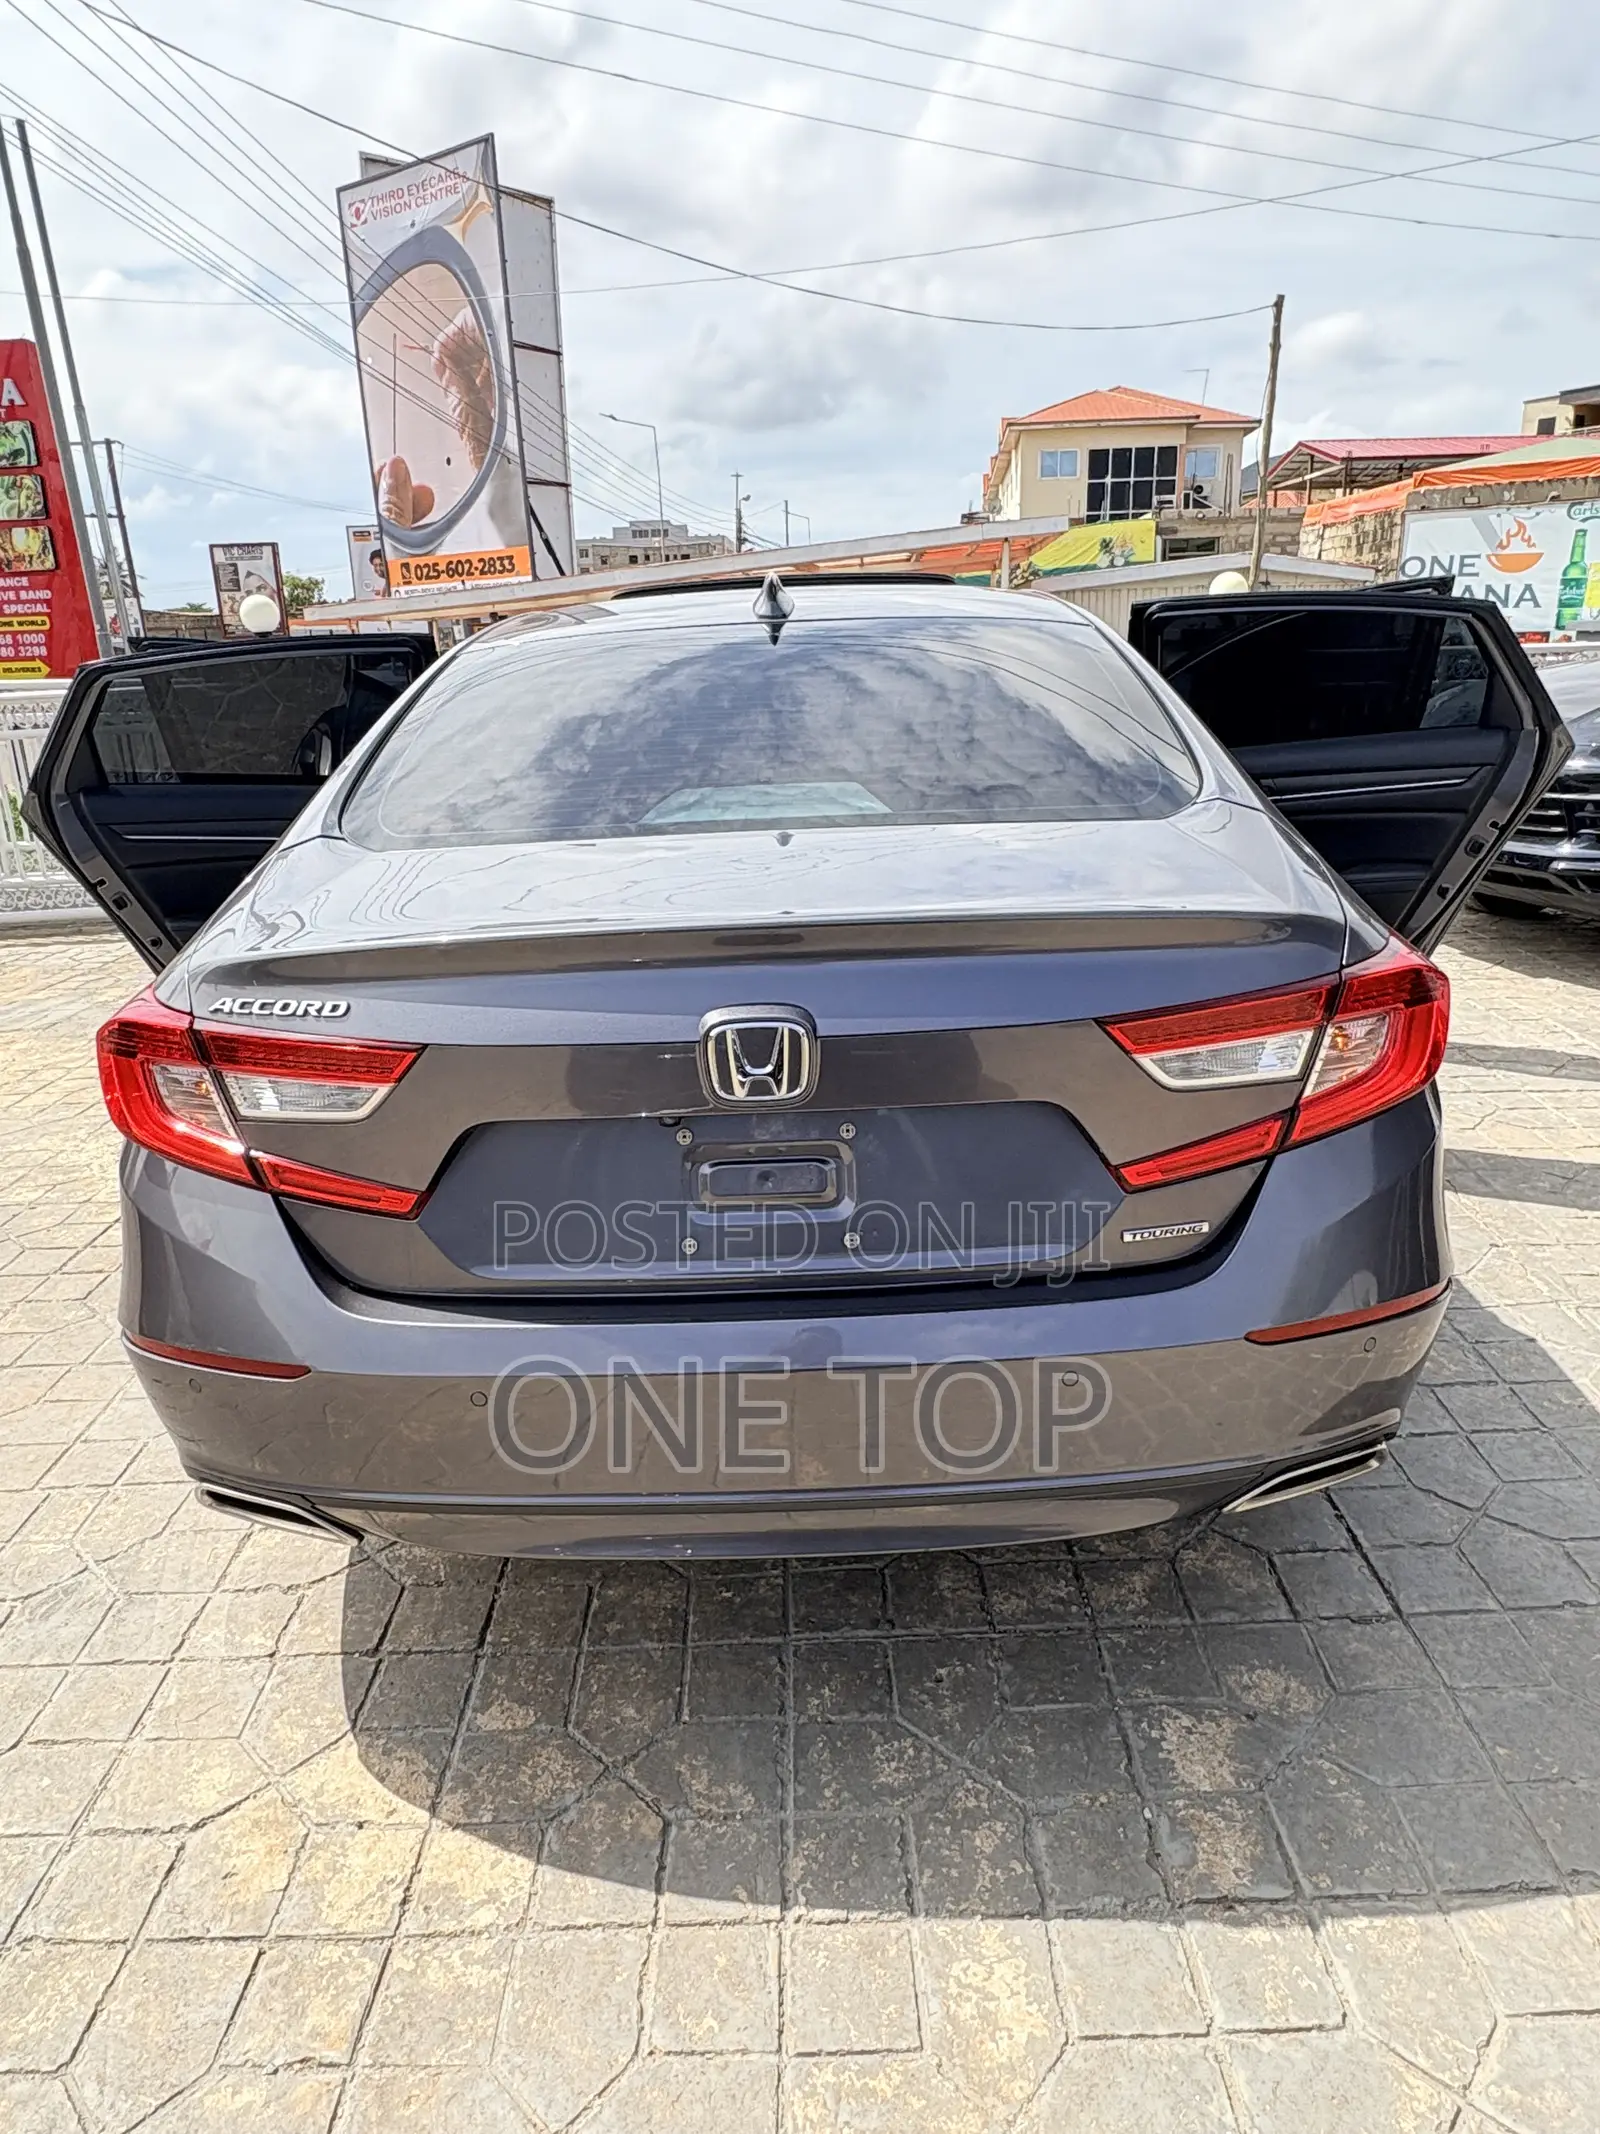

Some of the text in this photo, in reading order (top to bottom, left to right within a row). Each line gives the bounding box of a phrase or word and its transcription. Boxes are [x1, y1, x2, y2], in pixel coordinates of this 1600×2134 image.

[370, 187, 404, 208] THIRD
[407, 166, 460, 197] EYECARE
[371, 182, 460, 221] VISION CENTRE
[414, 554, 516, 581] 025-602-2833
[1400, 553, 1482, 578] ONE
[19, 589, 52, 600] BAND
[2, 603, 51, 614] SPECIAL
[16, 619, 47, 627] WORLD
[16, 633, 46, 645] 1000
[18, 645, 48, 657] 3298
[207, 997, 351, 1019] ACCORD
[1128, 1224, 1204, 1240] TOURING
